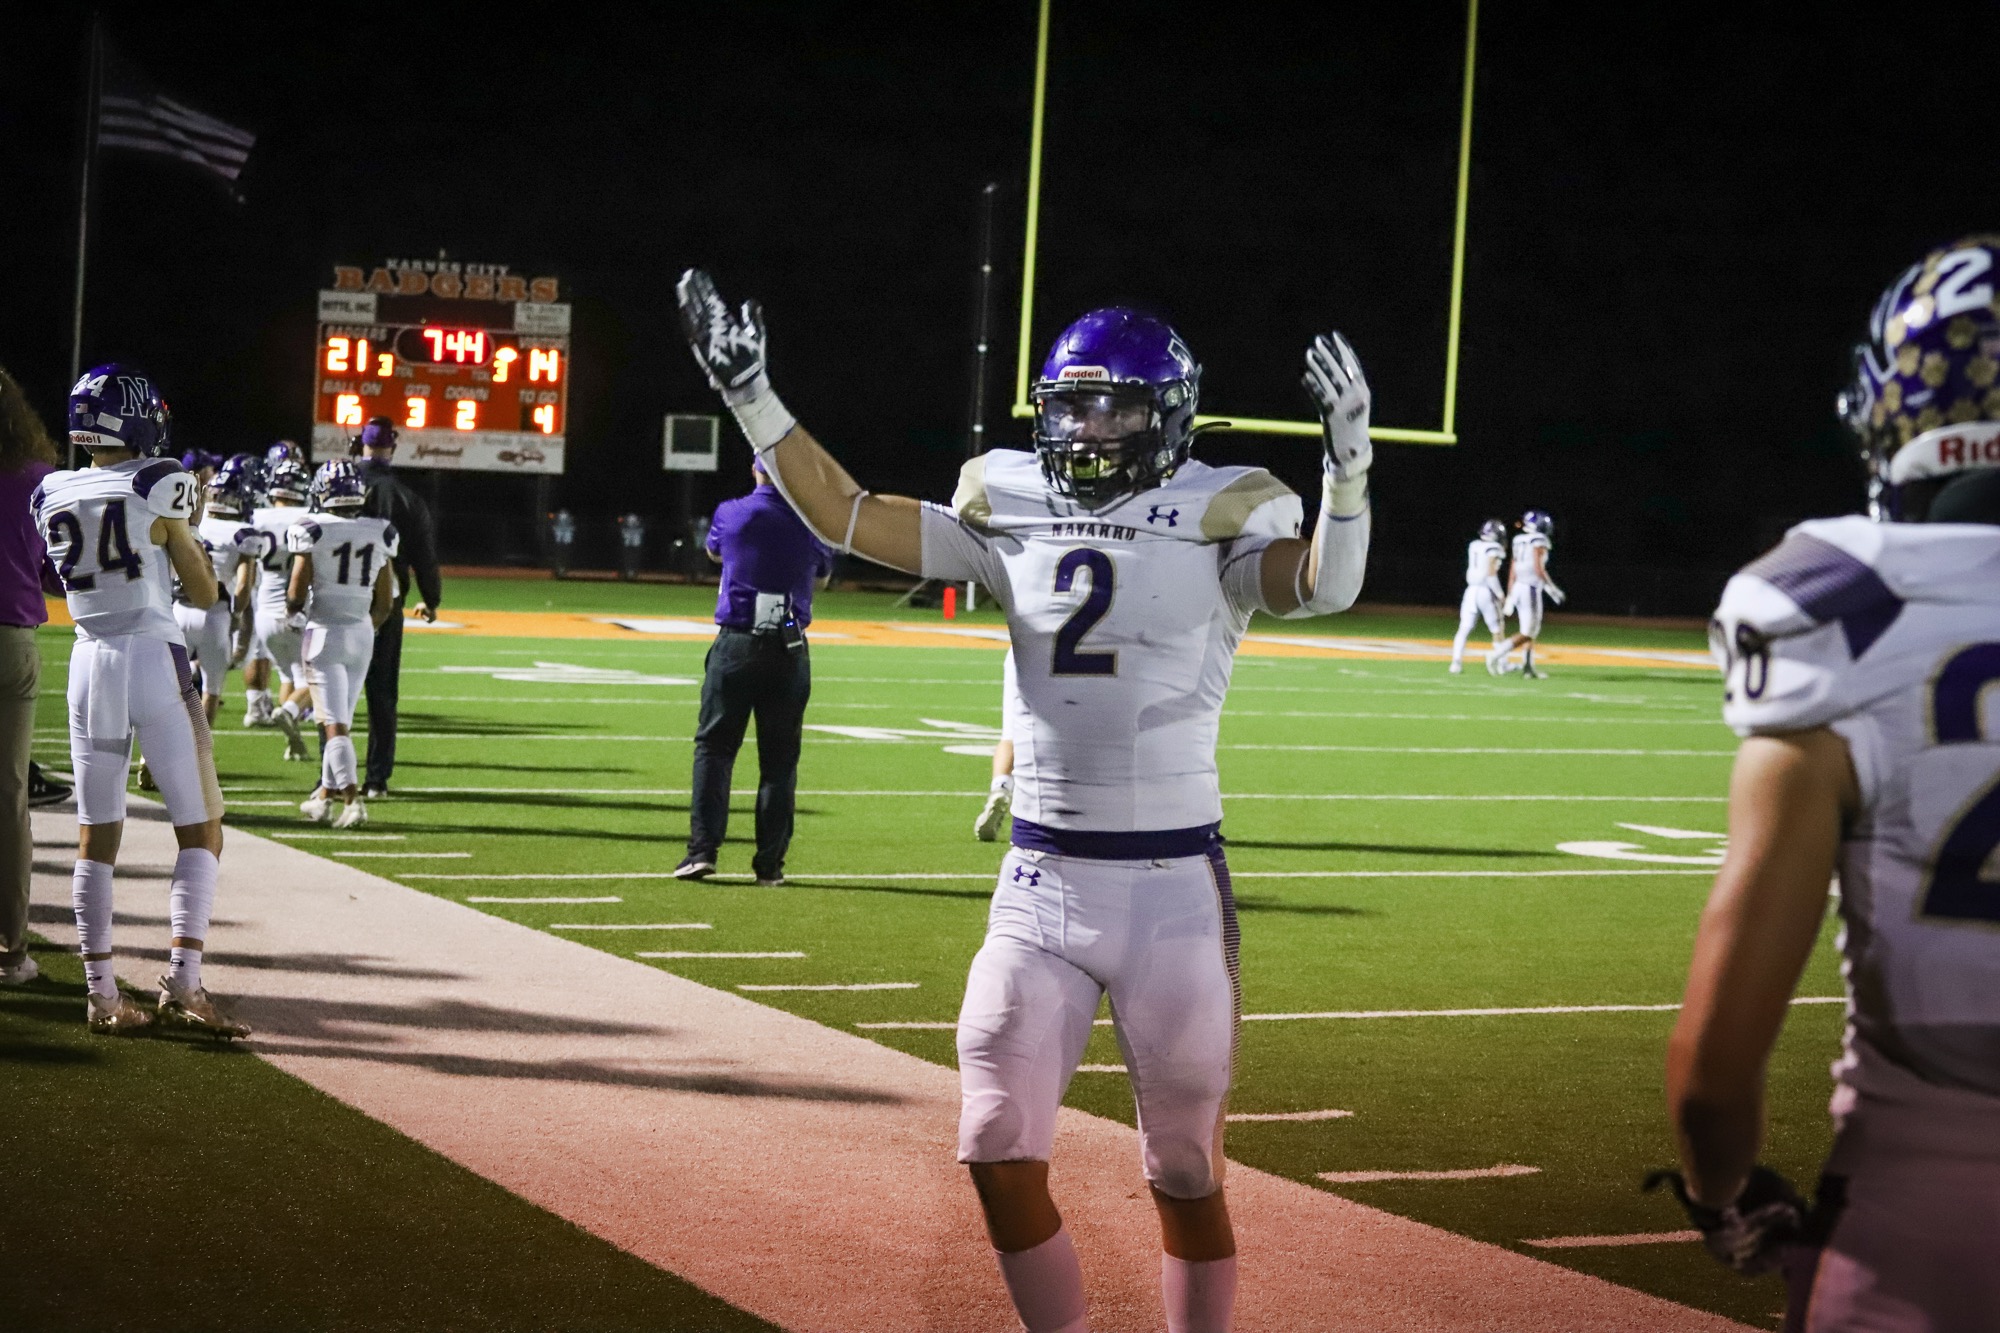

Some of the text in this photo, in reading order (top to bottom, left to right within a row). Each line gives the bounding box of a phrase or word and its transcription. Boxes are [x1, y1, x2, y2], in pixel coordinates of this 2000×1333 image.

[386, 259, 510, 276] KARNES CITY
[334, 266, 559, 302] BADGERS
[327, 337, 368, 372] 21
[377, 354, 394, 377] 3
[530, 348, 559, 382] 14
[492, 358, 508, 382] 3
[1064, 369, 1102, 378] Riddell
[70, 373, 109, 397] 24
[117, 376, 150, 418] N
[322, 379, 382, 396] BALL ON
[445, 386, 490, 400] DOWN
[519, 390, 558, 404] TO GO
[406, 397, 425, 427] 3
[456, 400, 476, 430] 2
[533, 404, 553, 433] 4
[337, 462, 355, 477] 11
[172, 482, 195, 510] 24
[47, 497, 143, 592] 24
[1052, 523, 1136, 541] NAVARRO
[332, 542, 374, 586] 11
[1050, 543, 1119, 678] 2
